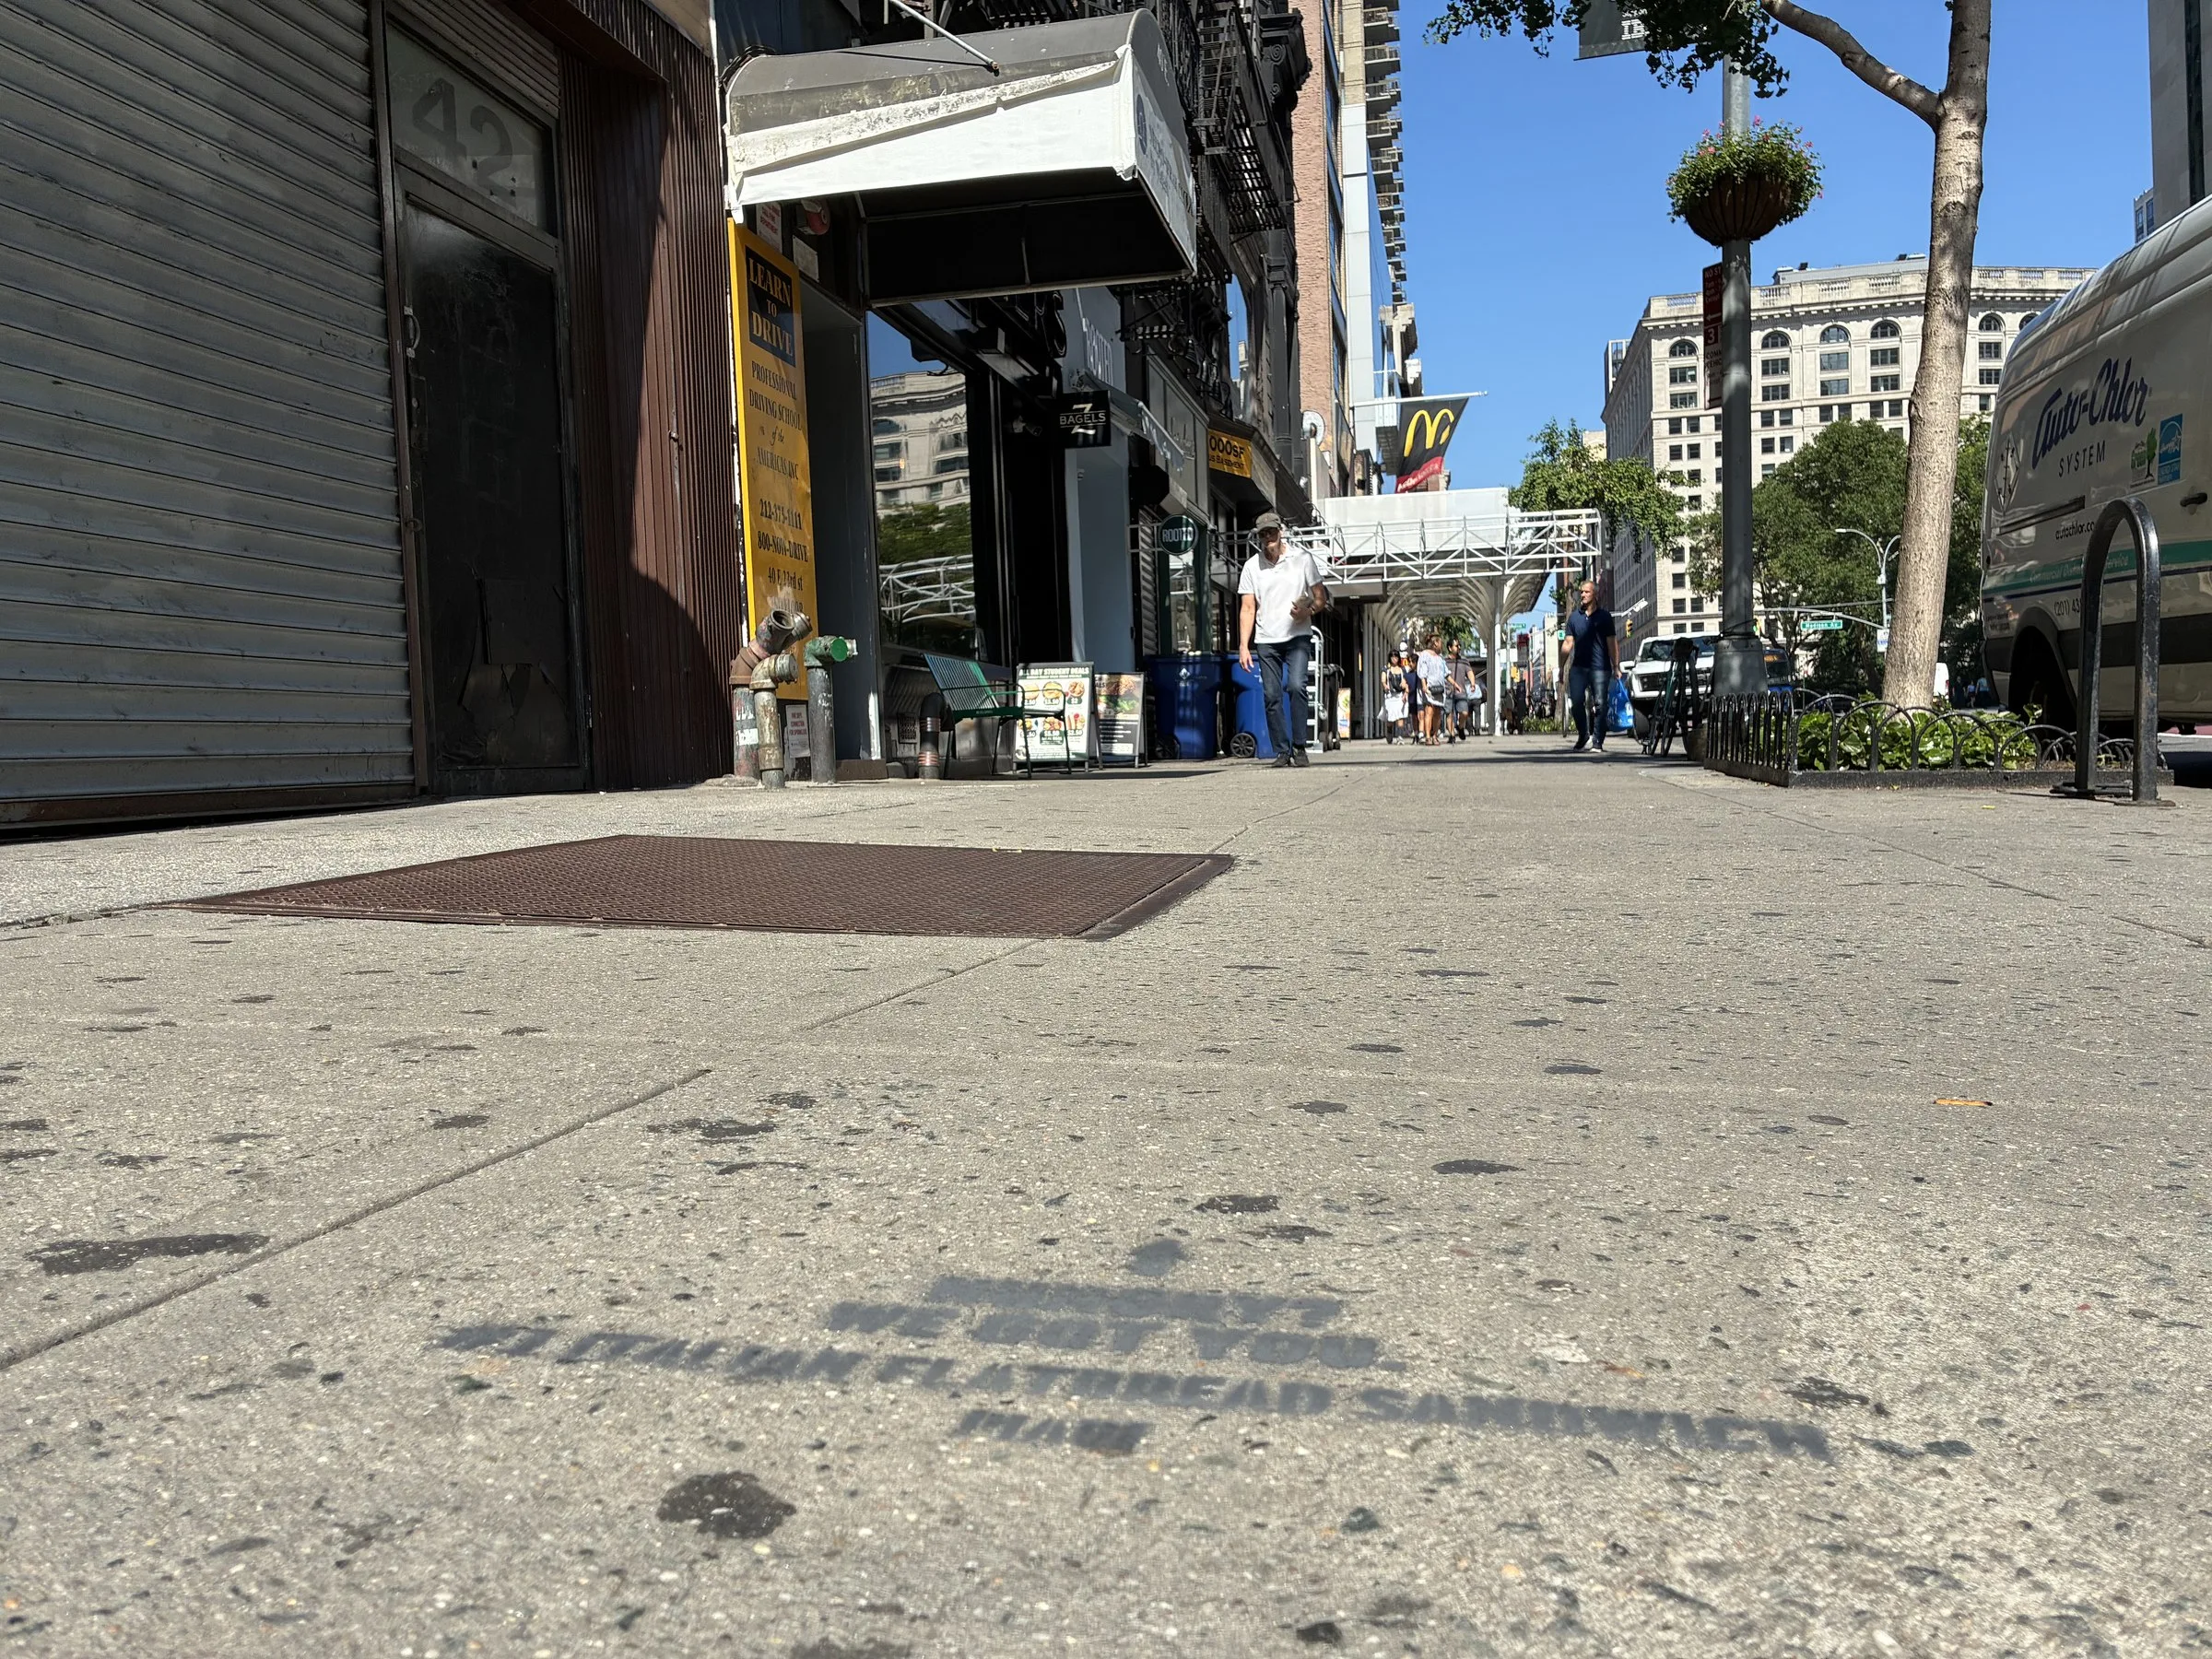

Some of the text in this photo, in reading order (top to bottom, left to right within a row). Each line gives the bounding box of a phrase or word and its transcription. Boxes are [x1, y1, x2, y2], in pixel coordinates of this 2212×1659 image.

[412, 77, 535, 206] 42
[748, 257, 791, 307] LEARN
[766, 300, 777, 318] TO
[751, 311, 794, 357] DRIVE
[1707, 327, 1715, 344] 3
[751, 360, 797, 401] PROFESSIONAL
[749, 389, 802, 431] DRIVING SCHOOL
[1059, 412, 1107, 426] BAGELS
[2032, 357, 2148, 470] Auto-Chlor
[770, 426, 778, 447] of
[757, 445, 788, 476] AMERICAS
[2058, 441, 2106, 477] SYSTEM
[759, 499, 802, 530] 212-375-1111
[2055, 521, 2095, 540] autochlor.co
[758, 531, 808, 562] 800-NOW-DRIVE
[2107, 555, 2129, 569] ervice
[2054, 598, 2081, 616] (201) 43
[828, 1301, 959, 1339] WE
[969, 1312, 1165, 1355] GOT
[557, 1332, 872, 1384] ITALIAN
[877, 1356, 1333, 1416] FLATBREAD
[1358, 1388, 1834, 1464] SANDWICH
